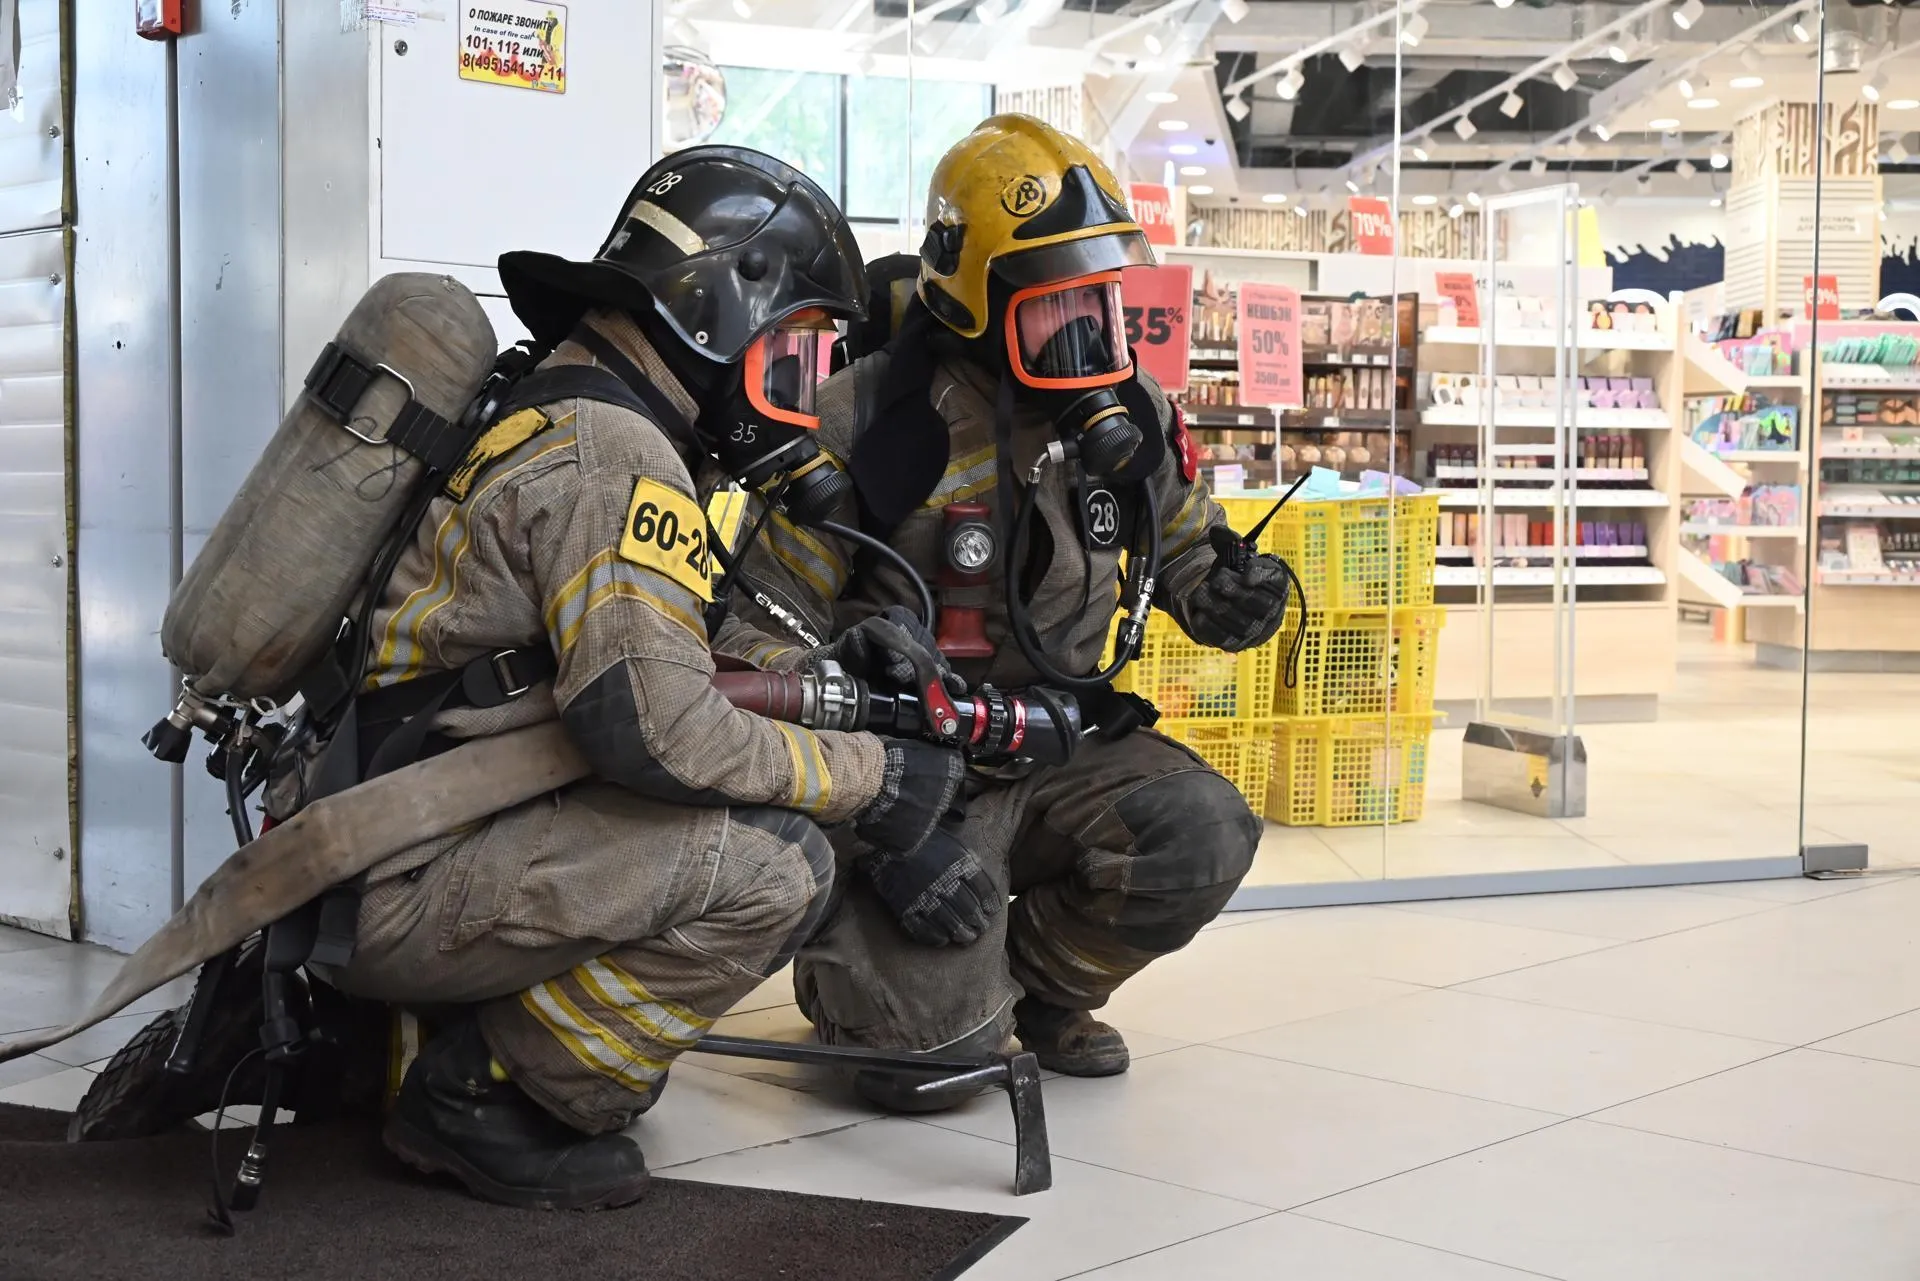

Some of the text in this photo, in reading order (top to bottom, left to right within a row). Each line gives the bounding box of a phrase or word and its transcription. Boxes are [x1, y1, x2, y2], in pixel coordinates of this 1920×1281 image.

[469, 8, 553, 32] О ПОЖАРЕ ЗВОНИТЬ
[497, 39, 520, 55] 112
[522, 46, 544, 58] или
[463, 52, 562, 81] 8(495)541-37-11
[647, 172, 683, 196] 28
[1013, 181, 1040, 211] 28
[1134, 198, 1176, 226] 70%
[1352, 211, 1392, 237] 70%
[1122, 306, 1184, 345] 35%
[1252, 329, 1289, 356] 50%
[730, 421, 758, 444] 35
[1090, 502, 1116, 533] 28
